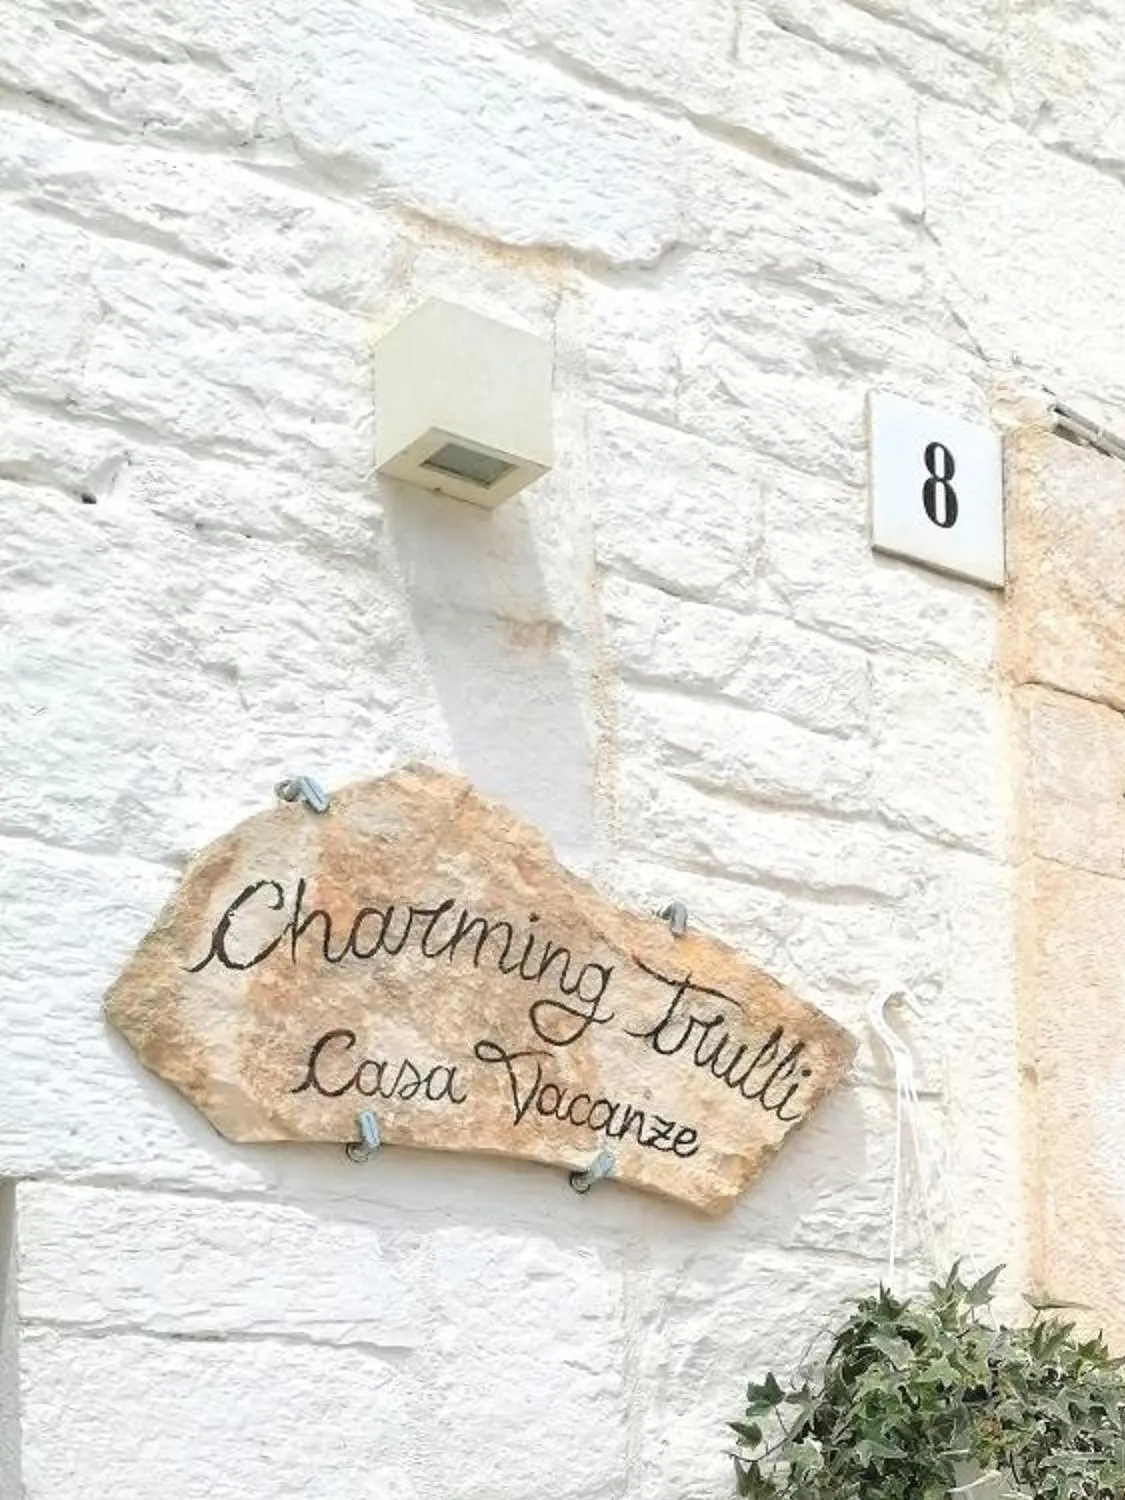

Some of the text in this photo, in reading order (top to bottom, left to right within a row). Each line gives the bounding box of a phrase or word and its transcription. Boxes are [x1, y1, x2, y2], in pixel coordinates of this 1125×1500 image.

[922, 440, 959, 529] 8
[182, 878, 814, 1122] Charming Trulli
[291, 1029, 700, 1160] Casa Vacanze
